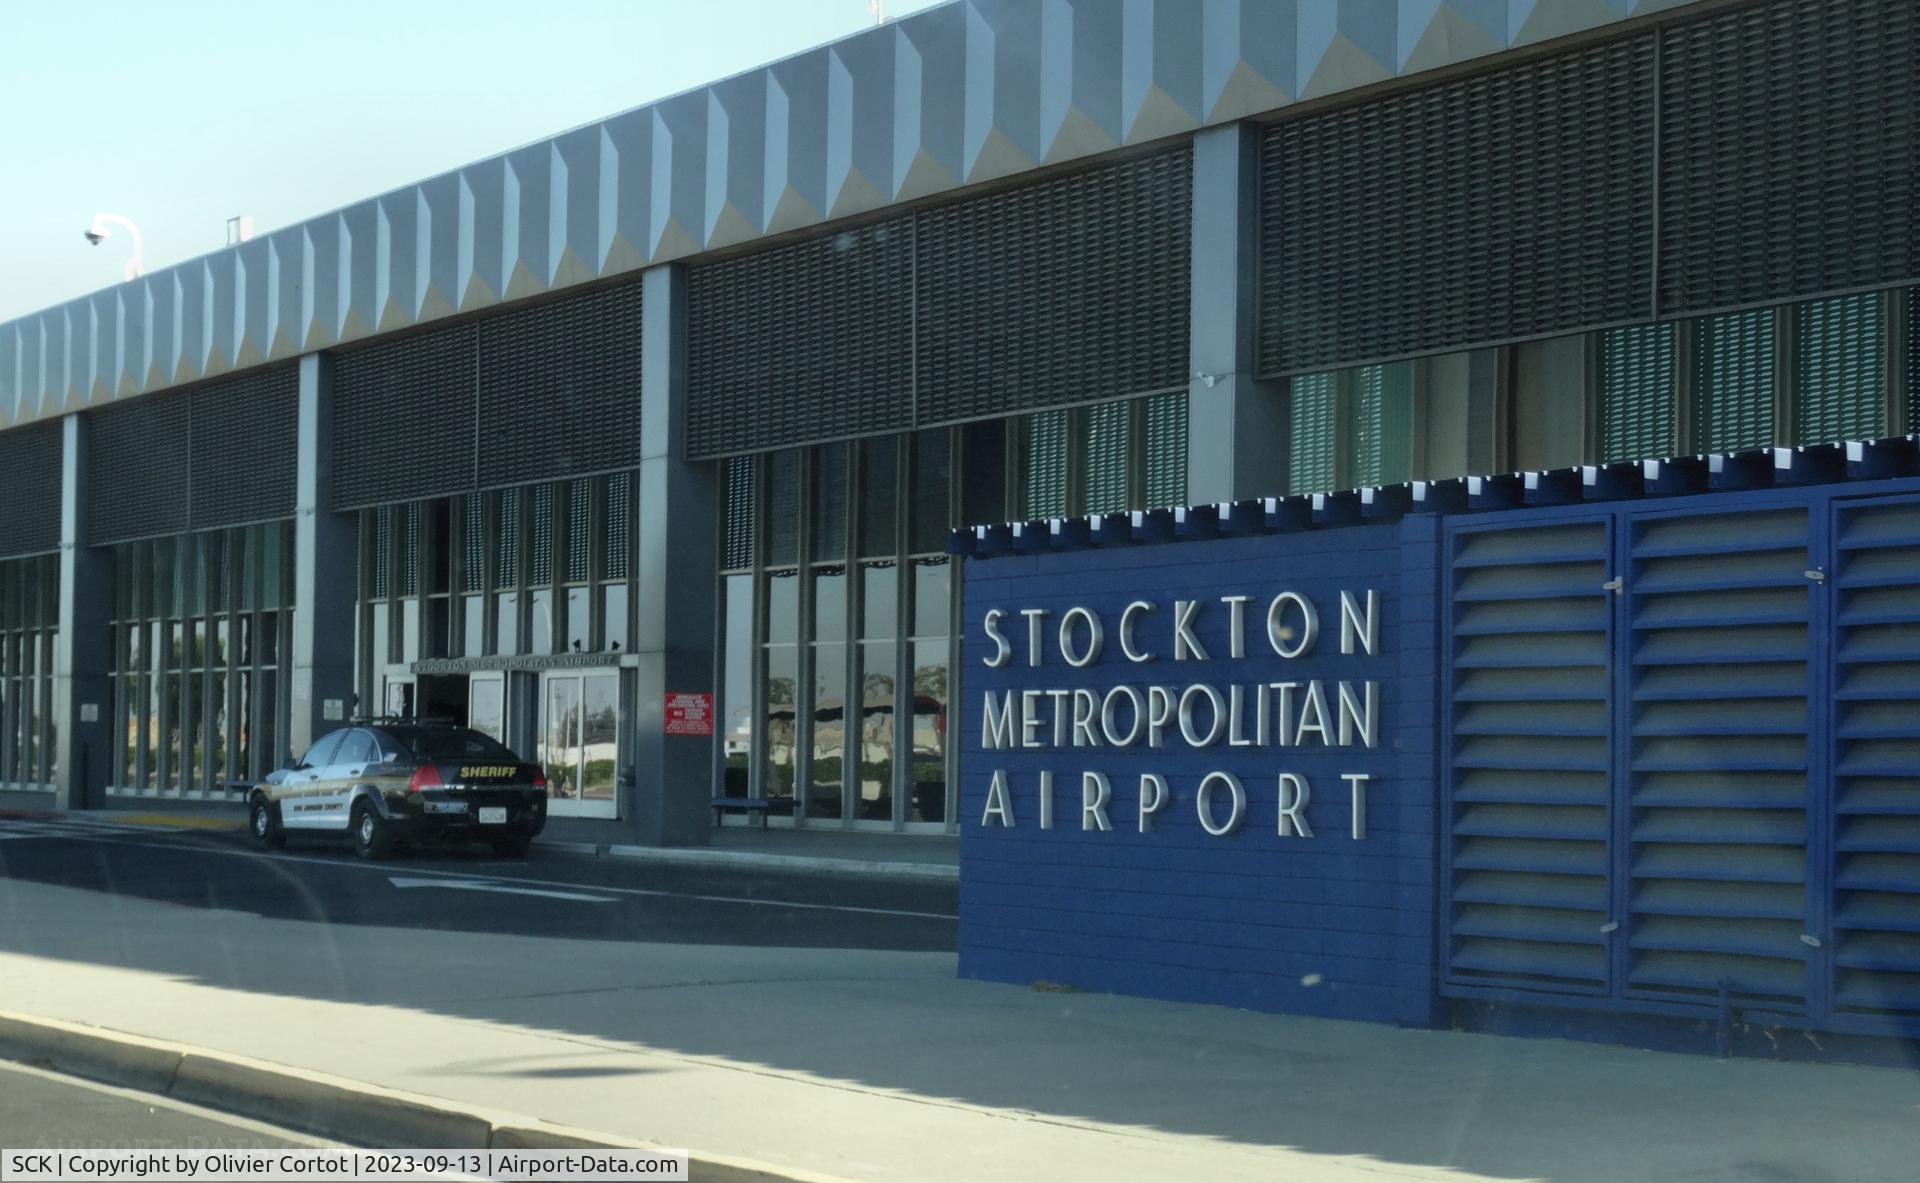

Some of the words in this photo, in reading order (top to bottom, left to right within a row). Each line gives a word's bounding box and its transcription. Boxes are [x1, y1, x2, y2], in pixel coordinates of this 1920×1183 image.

[983, 589, 1380, 668] STOCKTON
[982, 680, 1380, 750] METROPOLITAN
[460, 766, 517, 778] SHERIFF
[981, 768, 1376, 840] AIRPORT
